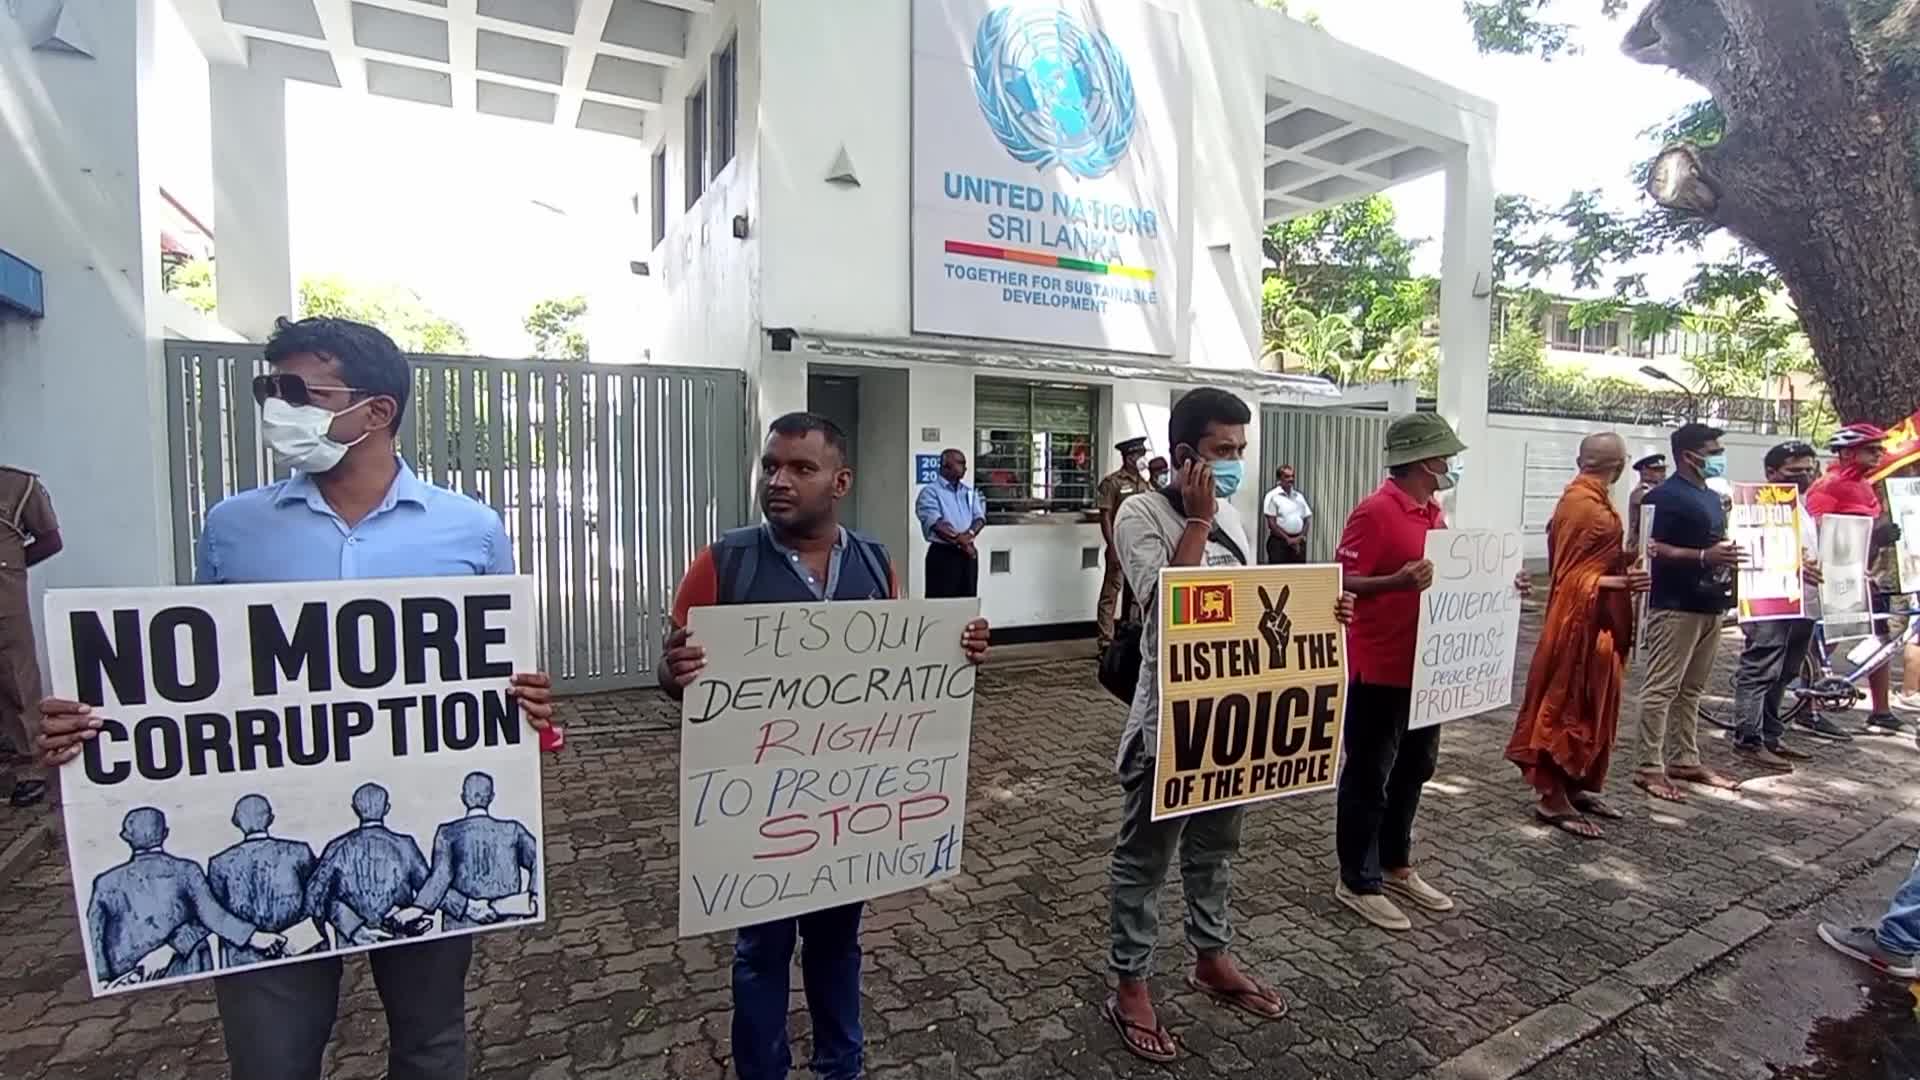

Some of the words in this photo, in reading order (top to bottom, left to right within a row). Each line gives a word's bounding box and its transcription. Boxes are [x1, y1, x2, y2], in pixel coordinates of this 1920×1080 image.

[944, 172, 1043, 212] UNITED
[1052, 191, 1158, 239] NATIONS
[988, 213, 1031, 243] SRI
[1041, 221, 1124, 266] LANKA
[944, 263, 1028, 288] TOGETHER
[1032, 275, 1061, 293] FOR
[1065, 279, 1158, 305] SUSTAINABLE
[1003, 287, 1107, 313] DEVELOPMENT
[1440, 532, 1519, 580] STOP
[70, 606, 221, 706] NO
[248, 594, 513, 696] MORE
[1170, 638, 1260, 683] LISTEN
[1294, 632, 1339, 670] THE
[1422, 622, 1505, 667] against
[688, 664, 975, 724] DEMOCRATIC
[82, 689, 522, 785] CORRUPTION
[755, 710, 936, 764] RIGHT
[1172, 683, 1338, 772] VOICE
[688, 769, 752, 827] TO
[766, 753, 958, 817] PROTEST
[1164, 775, 1195, 809] OF
[1201, 768, 1245, 802] THE
[1250, 754, 1330, 793] PEOPLE
[753, 795, 949, 860] STOP
[692, 843, 925, 916] VIOLATING
